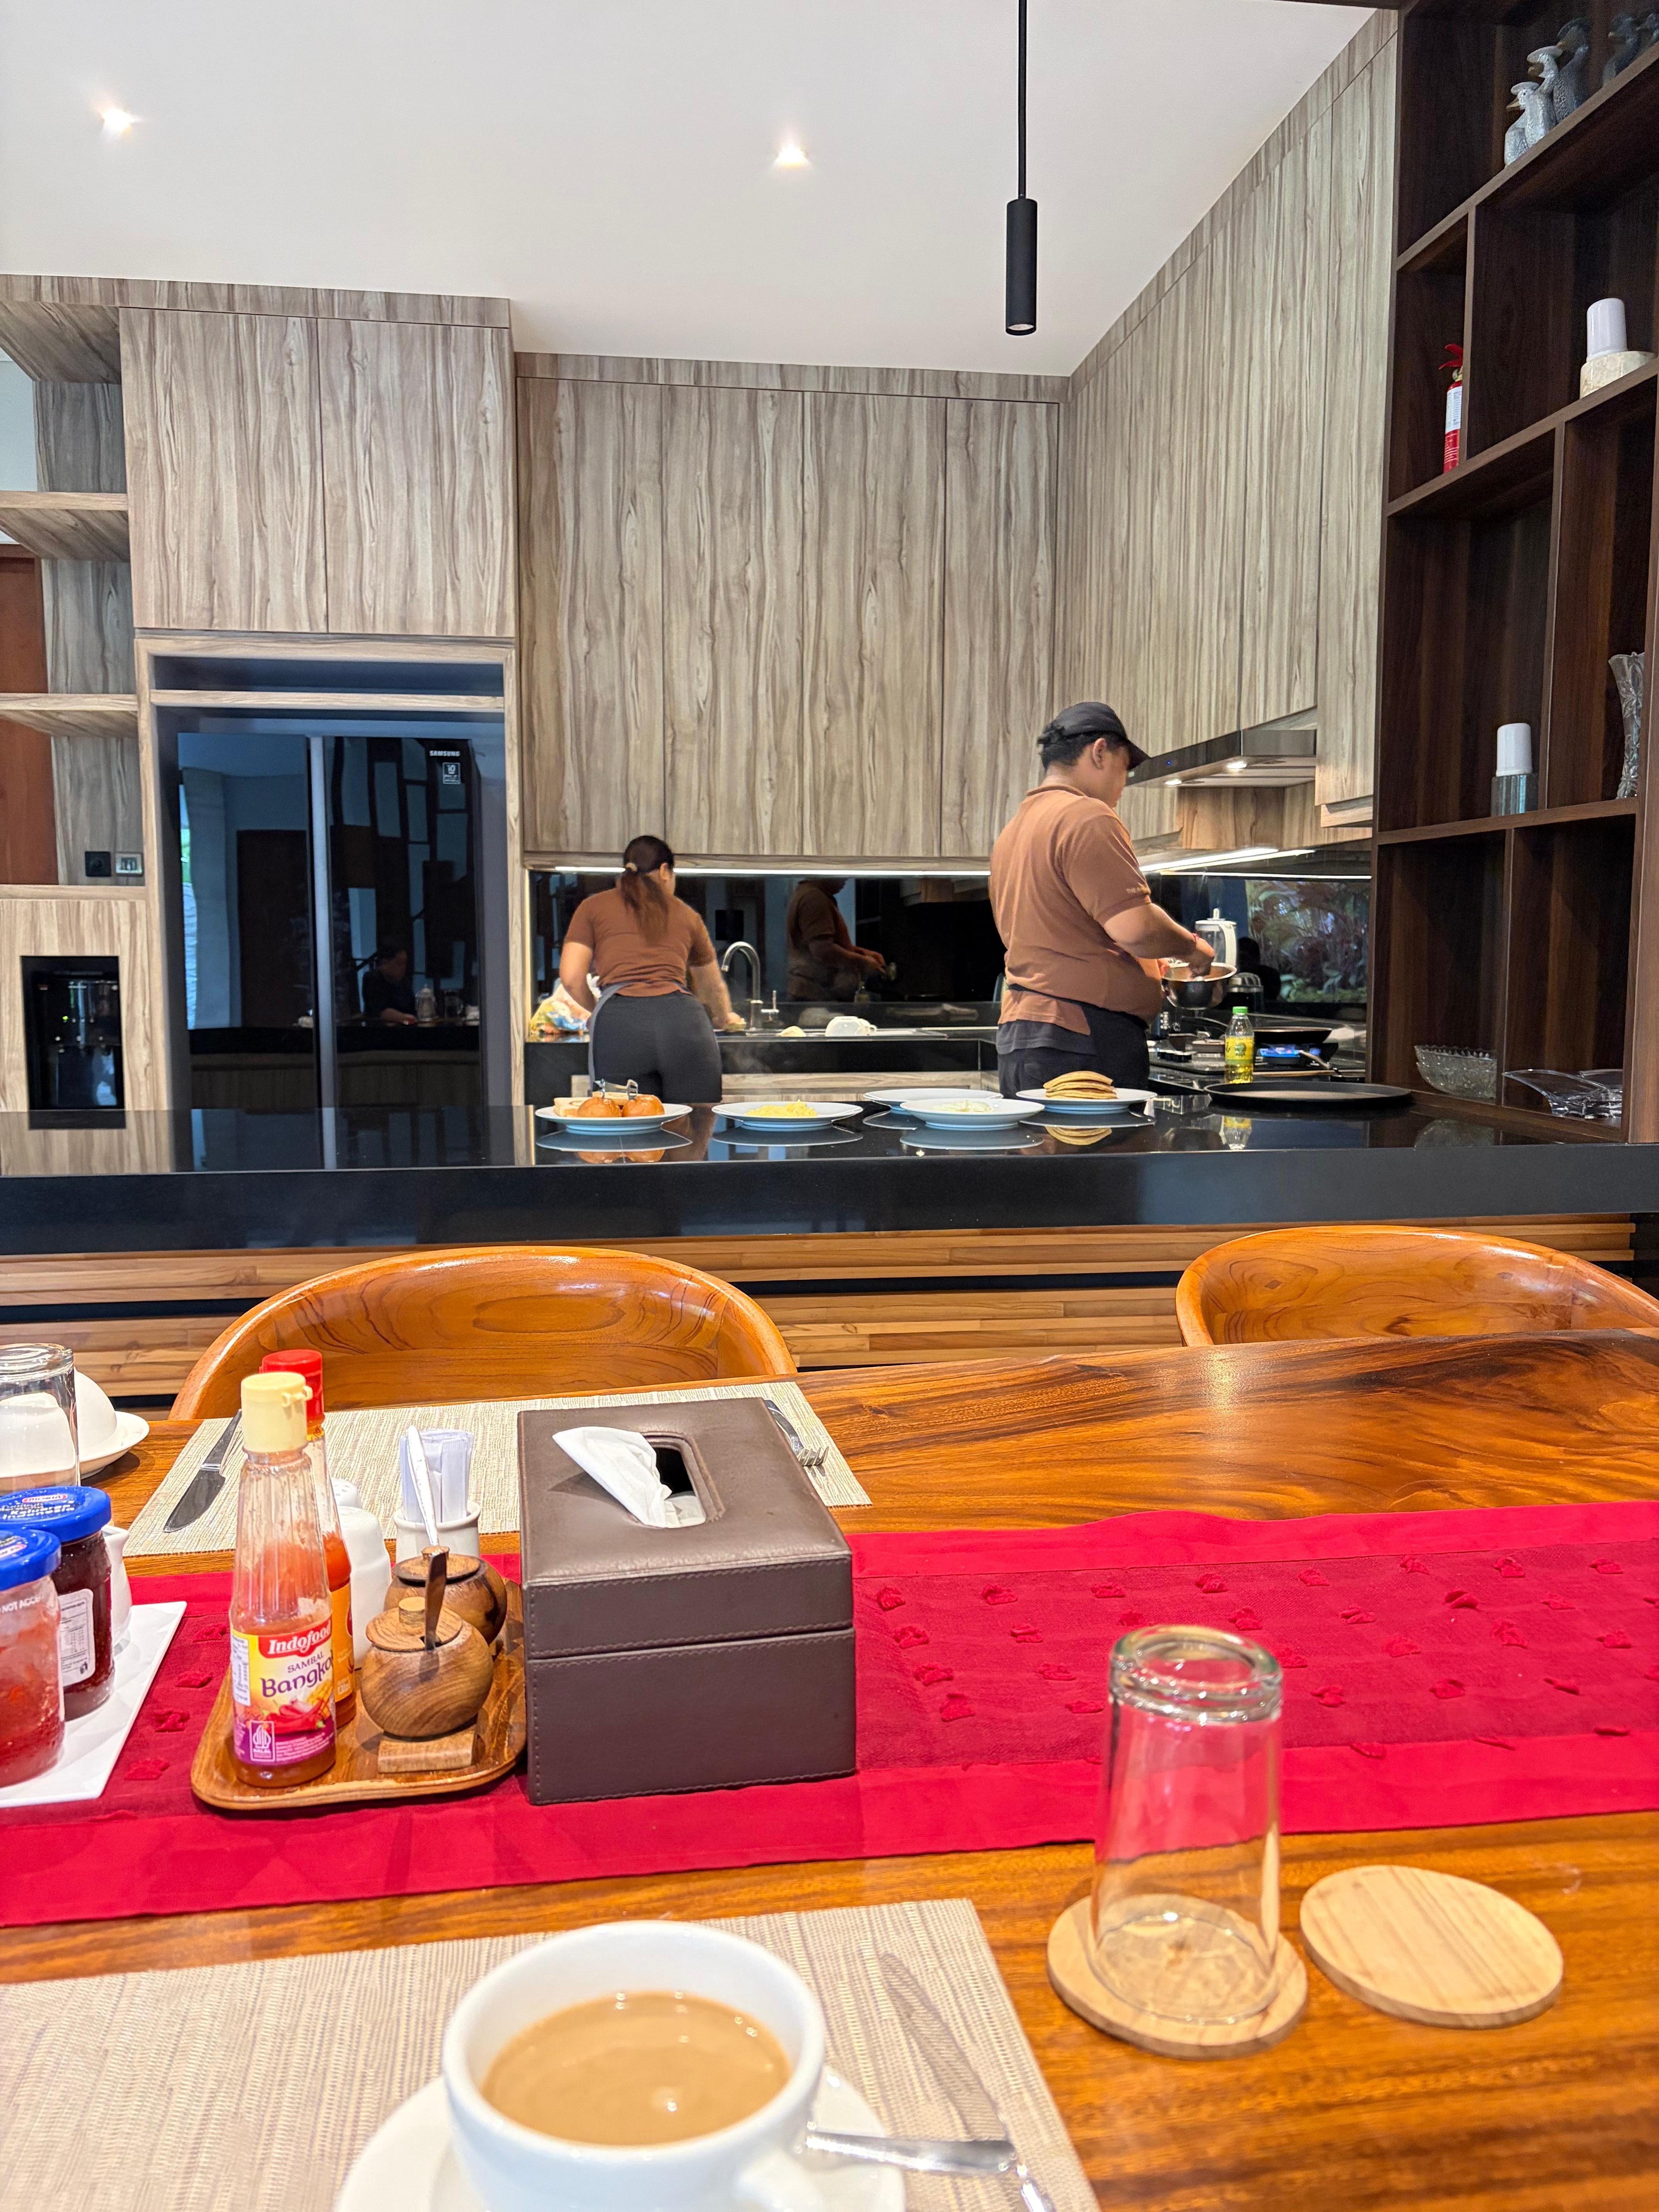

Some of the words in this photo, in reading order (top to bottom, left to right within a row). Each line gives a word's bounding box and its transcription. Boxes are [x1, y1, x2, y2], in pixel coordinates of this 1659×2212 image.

[2, 1601, 18, 1613] NOT
[268, 1618, 331, 1655] Indofood
[287, 1651, 325, 1673] SAMBAL
